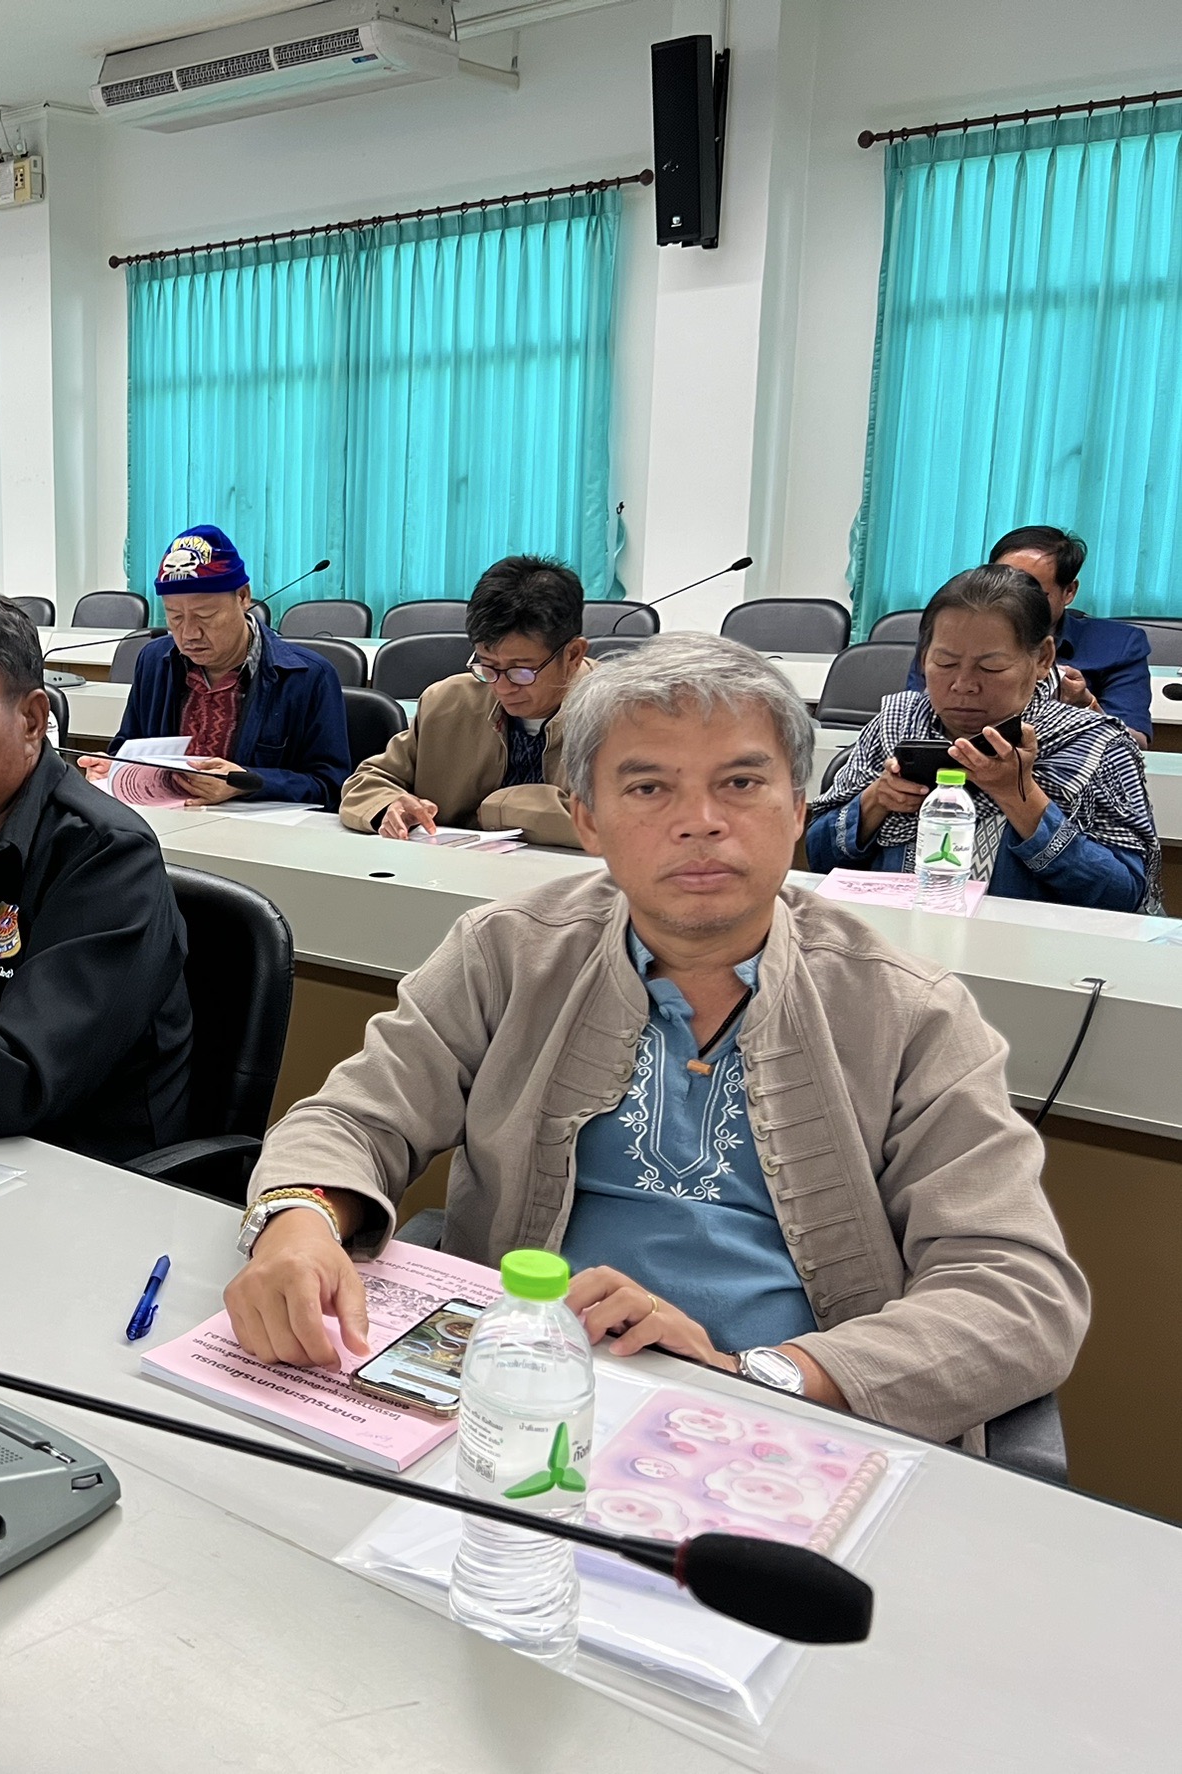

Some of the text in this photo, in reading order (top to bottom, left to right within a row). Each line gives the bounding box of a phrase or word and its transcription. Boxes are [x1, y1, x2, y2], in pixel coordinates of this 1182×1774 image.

[190, 1353, 367, 1424] เอกสารประกอบการฝึกอบรม
